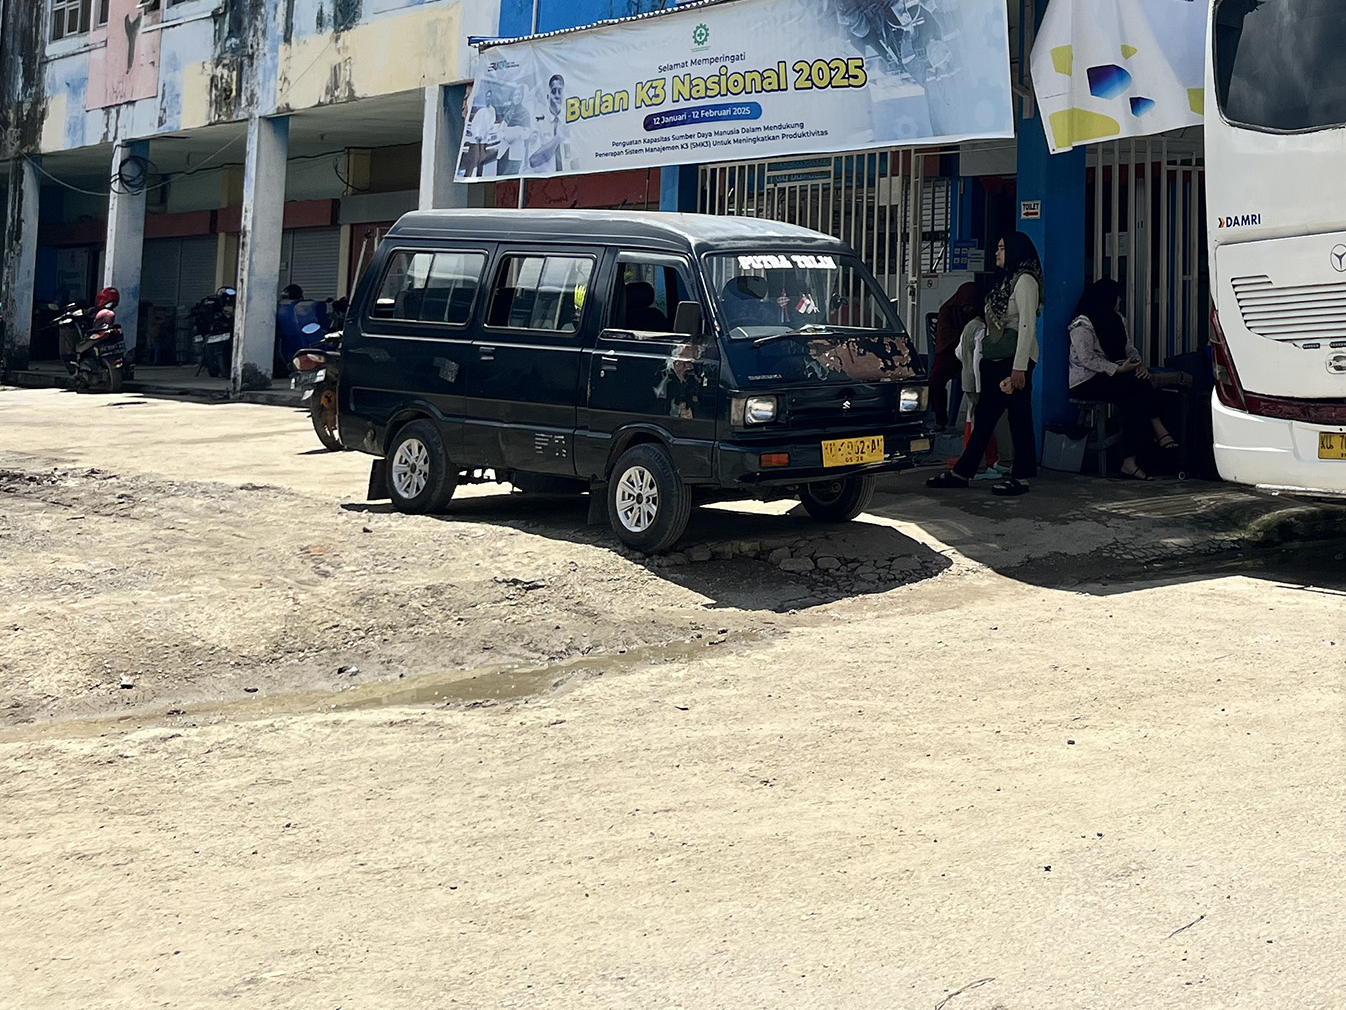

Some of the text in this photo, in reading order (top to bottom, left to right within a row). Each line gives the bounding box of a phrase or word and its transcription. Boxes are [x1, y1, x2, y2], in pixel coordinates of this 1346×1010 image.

[657, 51, 747, 74] Selamat Memperingati
[564, 57, 868, 124] Bulan K3 Nasional 2025
[653, 116, 660, 125] 12
[661, 112, 687, 124] Januari
[691, 110, 699, 119] 12
[701, 107, 731, 118] Februari
[732, 106, 751, 115] 2025
[595, 129, 829, 159] Penerapan Sistem Manajemen K3 (SMK3) Untuk Meningkatkan Produktivitas
[611, 121, 805, 148] Penguatan Kapasitas Sumber Daya Manusia Dalam Mendukung
[1022, 202, 1040, 211] TOILET
[1225, 213, 1262, 228] DAMRI
